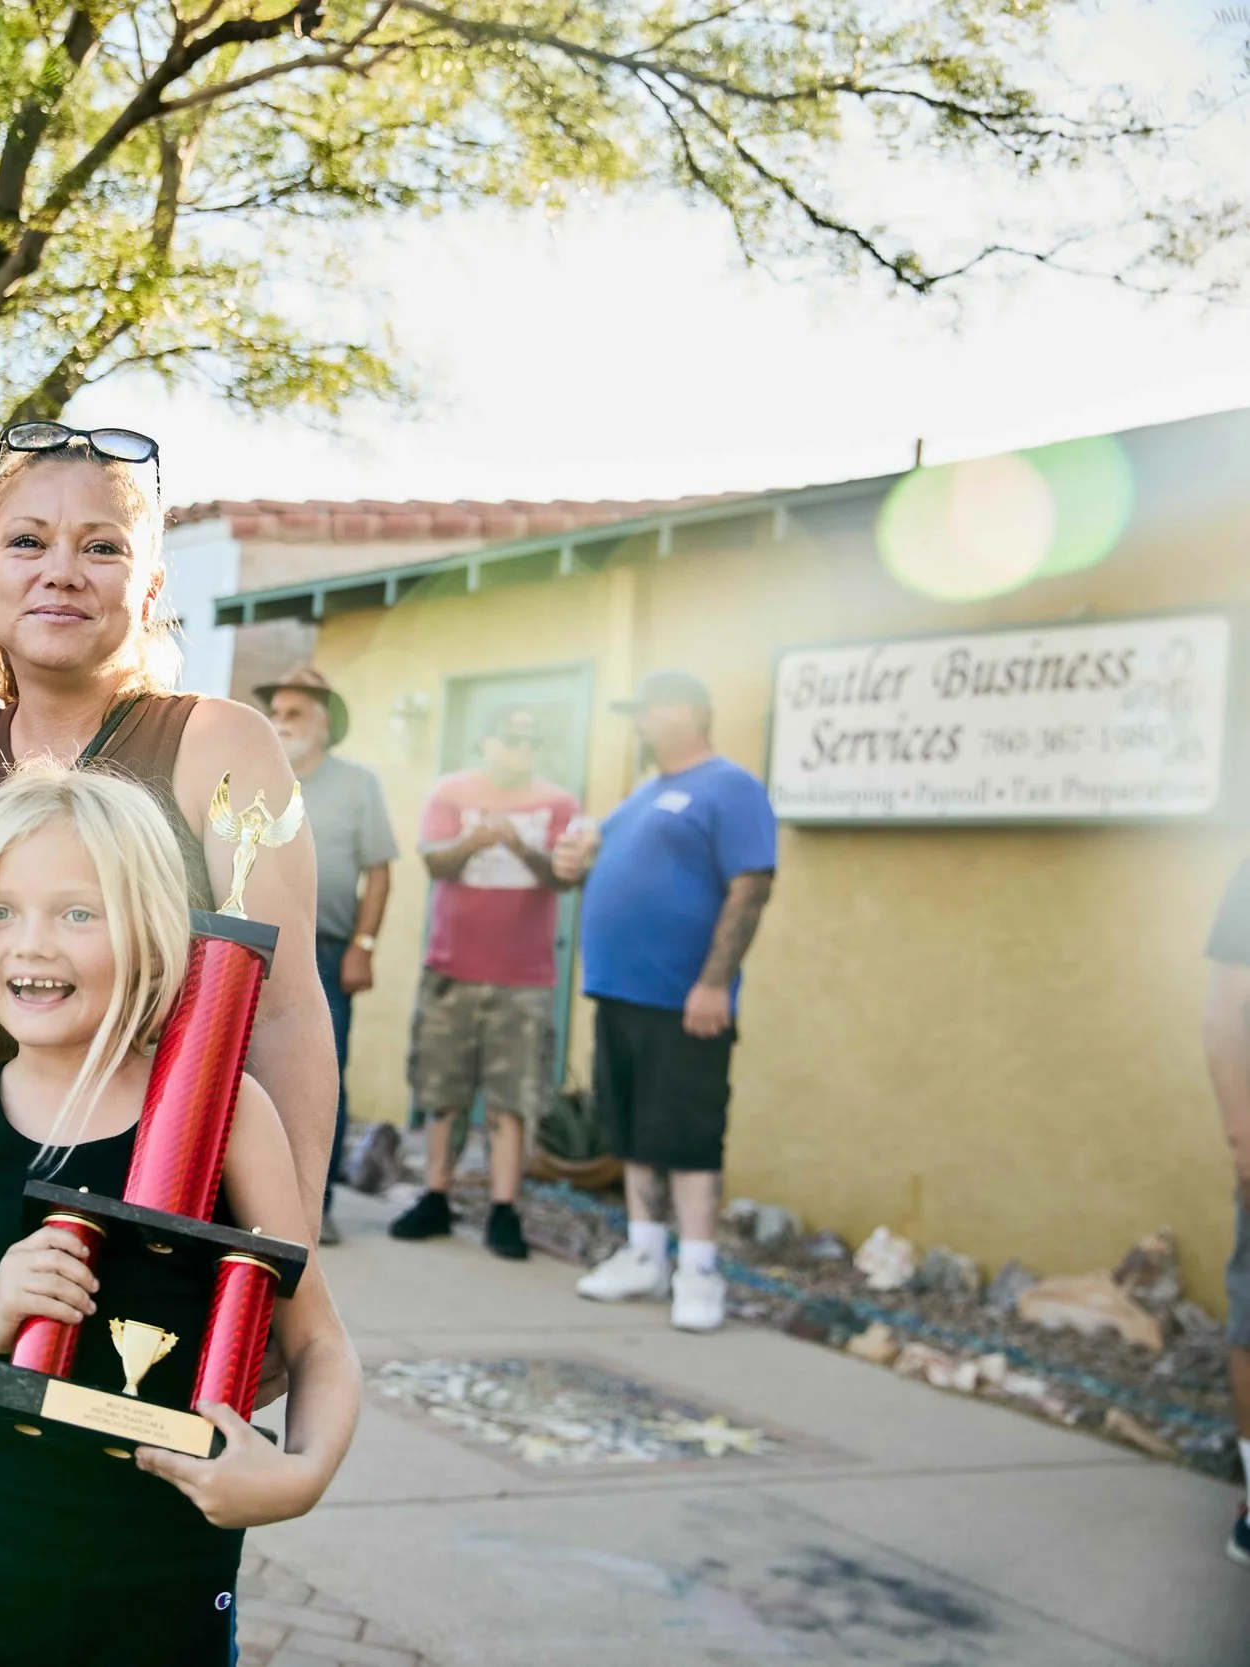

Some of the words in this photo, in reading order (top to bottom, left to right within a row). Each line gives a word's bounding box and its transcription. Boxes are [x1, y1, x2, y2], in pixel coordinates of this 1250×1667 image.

[785, 648, 911, 710] Butler
[932, 640, 1138, 700] Business
[800, 714, 964, 771] Services
[915, 779, 988, 812] Payroll
[1012, 778, 1052, 803] Tax
